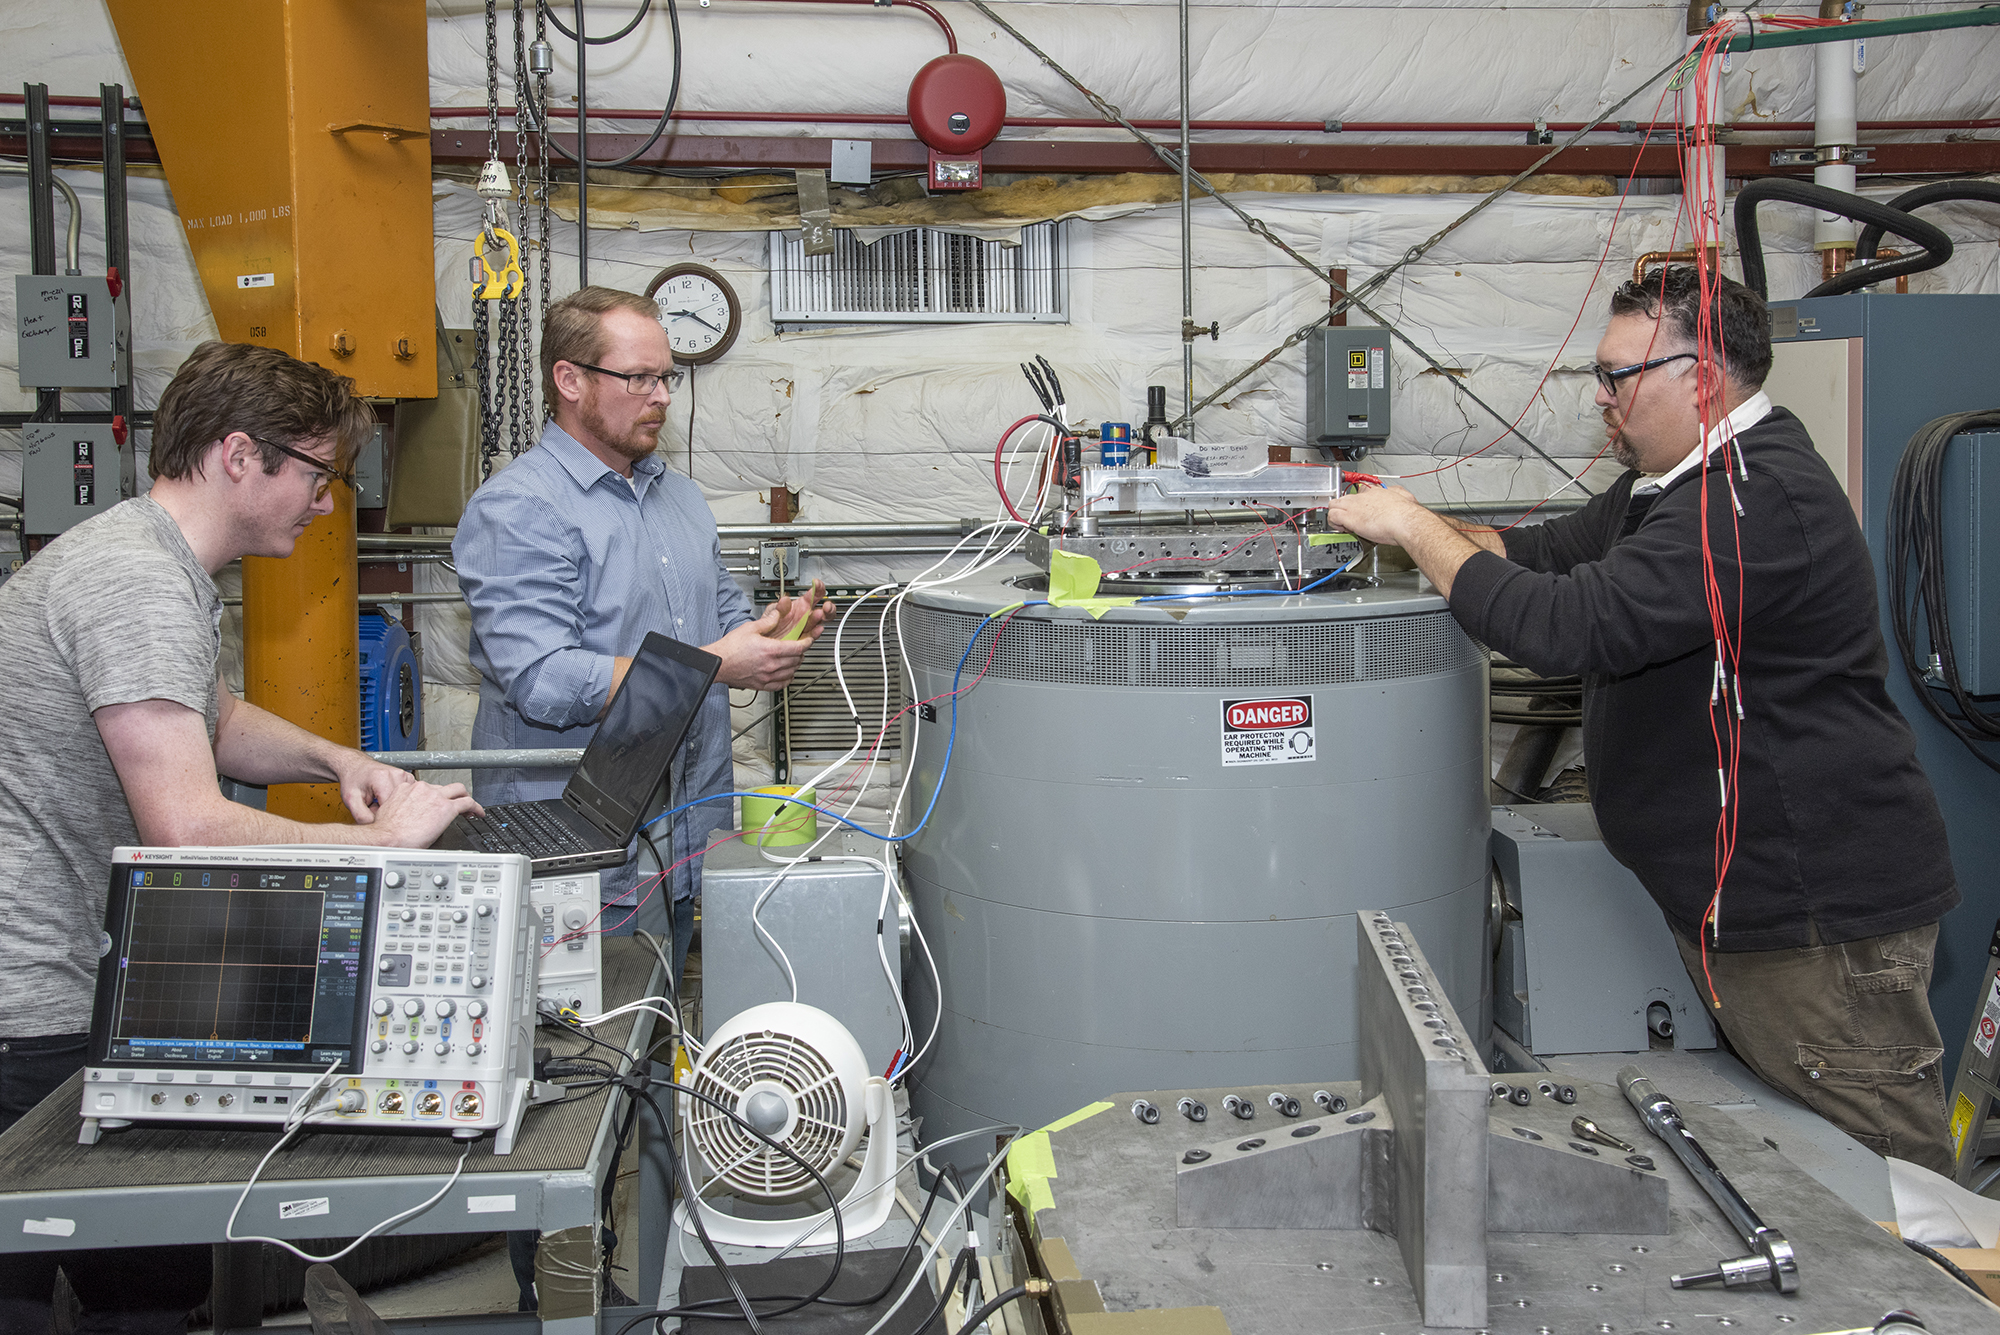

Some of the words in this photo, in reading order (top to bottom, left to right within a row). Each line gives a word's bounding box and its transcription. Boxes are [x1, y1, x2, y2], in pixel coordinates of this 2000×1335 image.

[188, 218, 204, 230] MAX
[210, 214, 232, 227] LOAD
[240, 209, 266, 223] 1,000
[272, 205, 290, 218] LBS
[682, 280, 692, 289] 12
[72, 295, 82, 308] ON
[659, 297, 667, 305] 10
[712, 293, 719, 301] 2
[717, 308, 724, 316] 3
[24, 315, 44, 326] Heat
[250, 326, 266, 337] 058
[689, 340, 696, 348] 6
[704, 335, 711, 343] 5
[74, 338, 83, 357] OFF
[79, 442, 88, 455] ON
[80, 485, 88, 504] OFF
[1116, 542, 1124, 551] 2
[1232, 705, 1304, 725] DANGER
[282, 1204, 292, 1212] 3M
